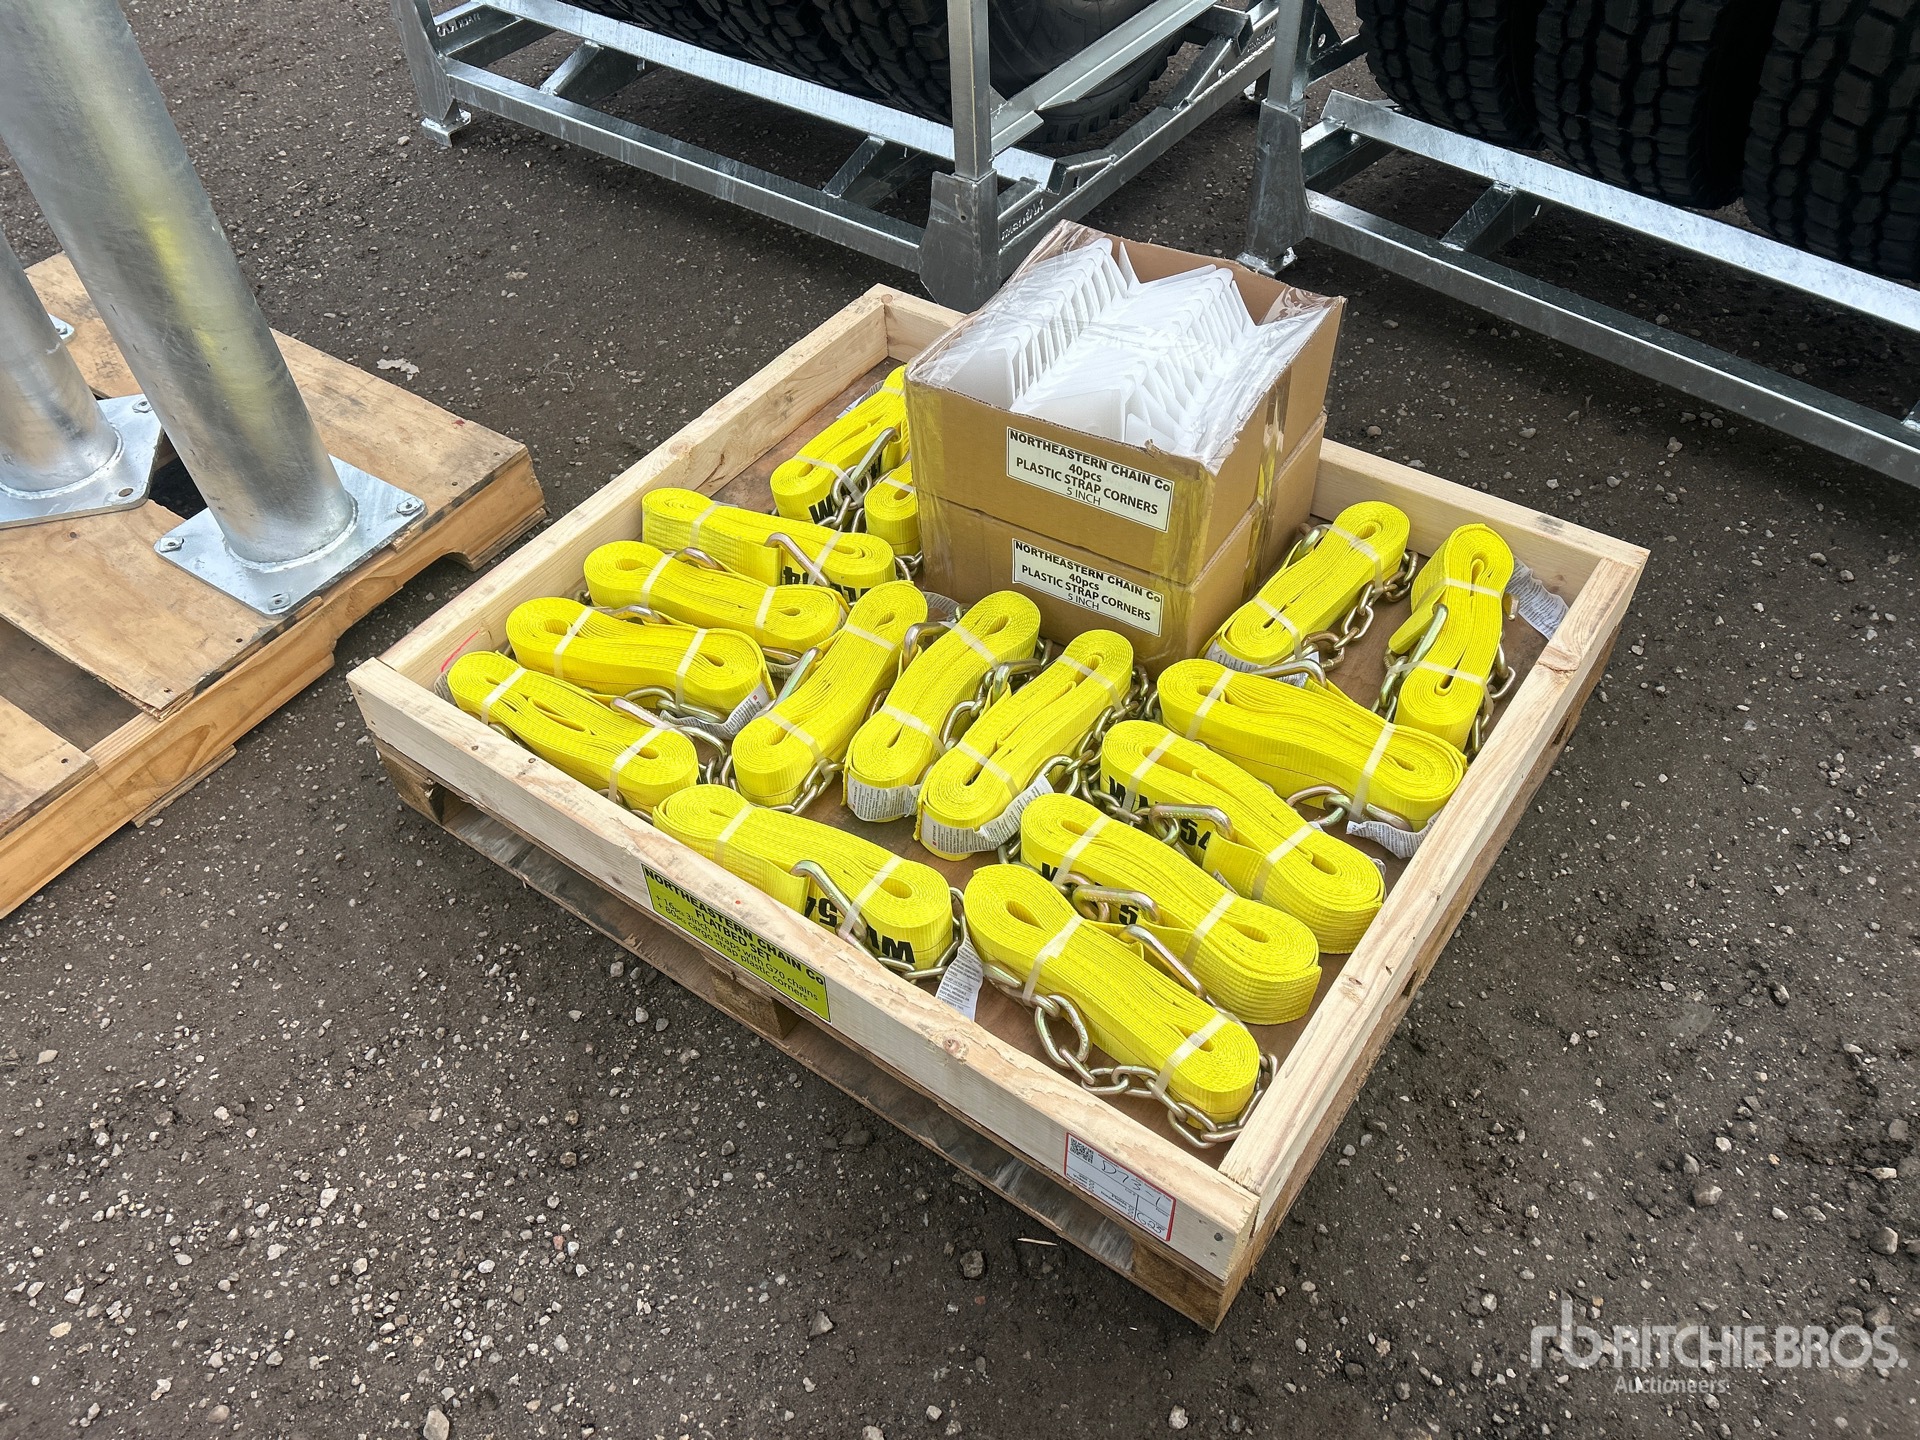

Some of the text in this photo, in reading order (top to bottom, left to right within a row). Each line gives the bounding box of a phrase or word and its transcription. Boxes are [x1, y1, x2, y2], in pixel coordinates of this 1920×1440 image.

[1010, 430, 1171, 492] NORTHEASTERN CHAIN Co
[1016, 457, 1158, 515] PLASTIC STRAP CORNERS
[1069, 463, 1102, 483] 40pcs
[1066, 486, 1101, 506] 5 INCH
[1015, 541, 1104, 581] NORTHEASTERN
[1107, 576, 1143, 597] CHAIN
[1146, 590, 1161, 603] Co
[1021, 564, 1063, 588] PLASTIC
[1065, 581, 1099, 600] STRAP
[1101, 594, 1151, 621] CORNERS
[1069, 573, 1100, 591] 40pcs
[1067, 592, 1100, 611] 5 INCH
[644, 867, 824, 985] NORTHEASTERN CHAIN Co
[663, 898, 685, 917] 16pcs
[686, 912, 711, 933] 3inch
[713, 931, 740, 953] straps
[743, 949, 764, 966] with
[765, 963, 785, 980] G70
[787, 977, 818, 1001] chains
[695, 908, 771, 962] FLATBED SET
[688, 921, 713, 941] cargo
[715, 939, 739, 960] strap
[740, 955, 771, 978] plastic
[772, 975, 808, 1001] corners
